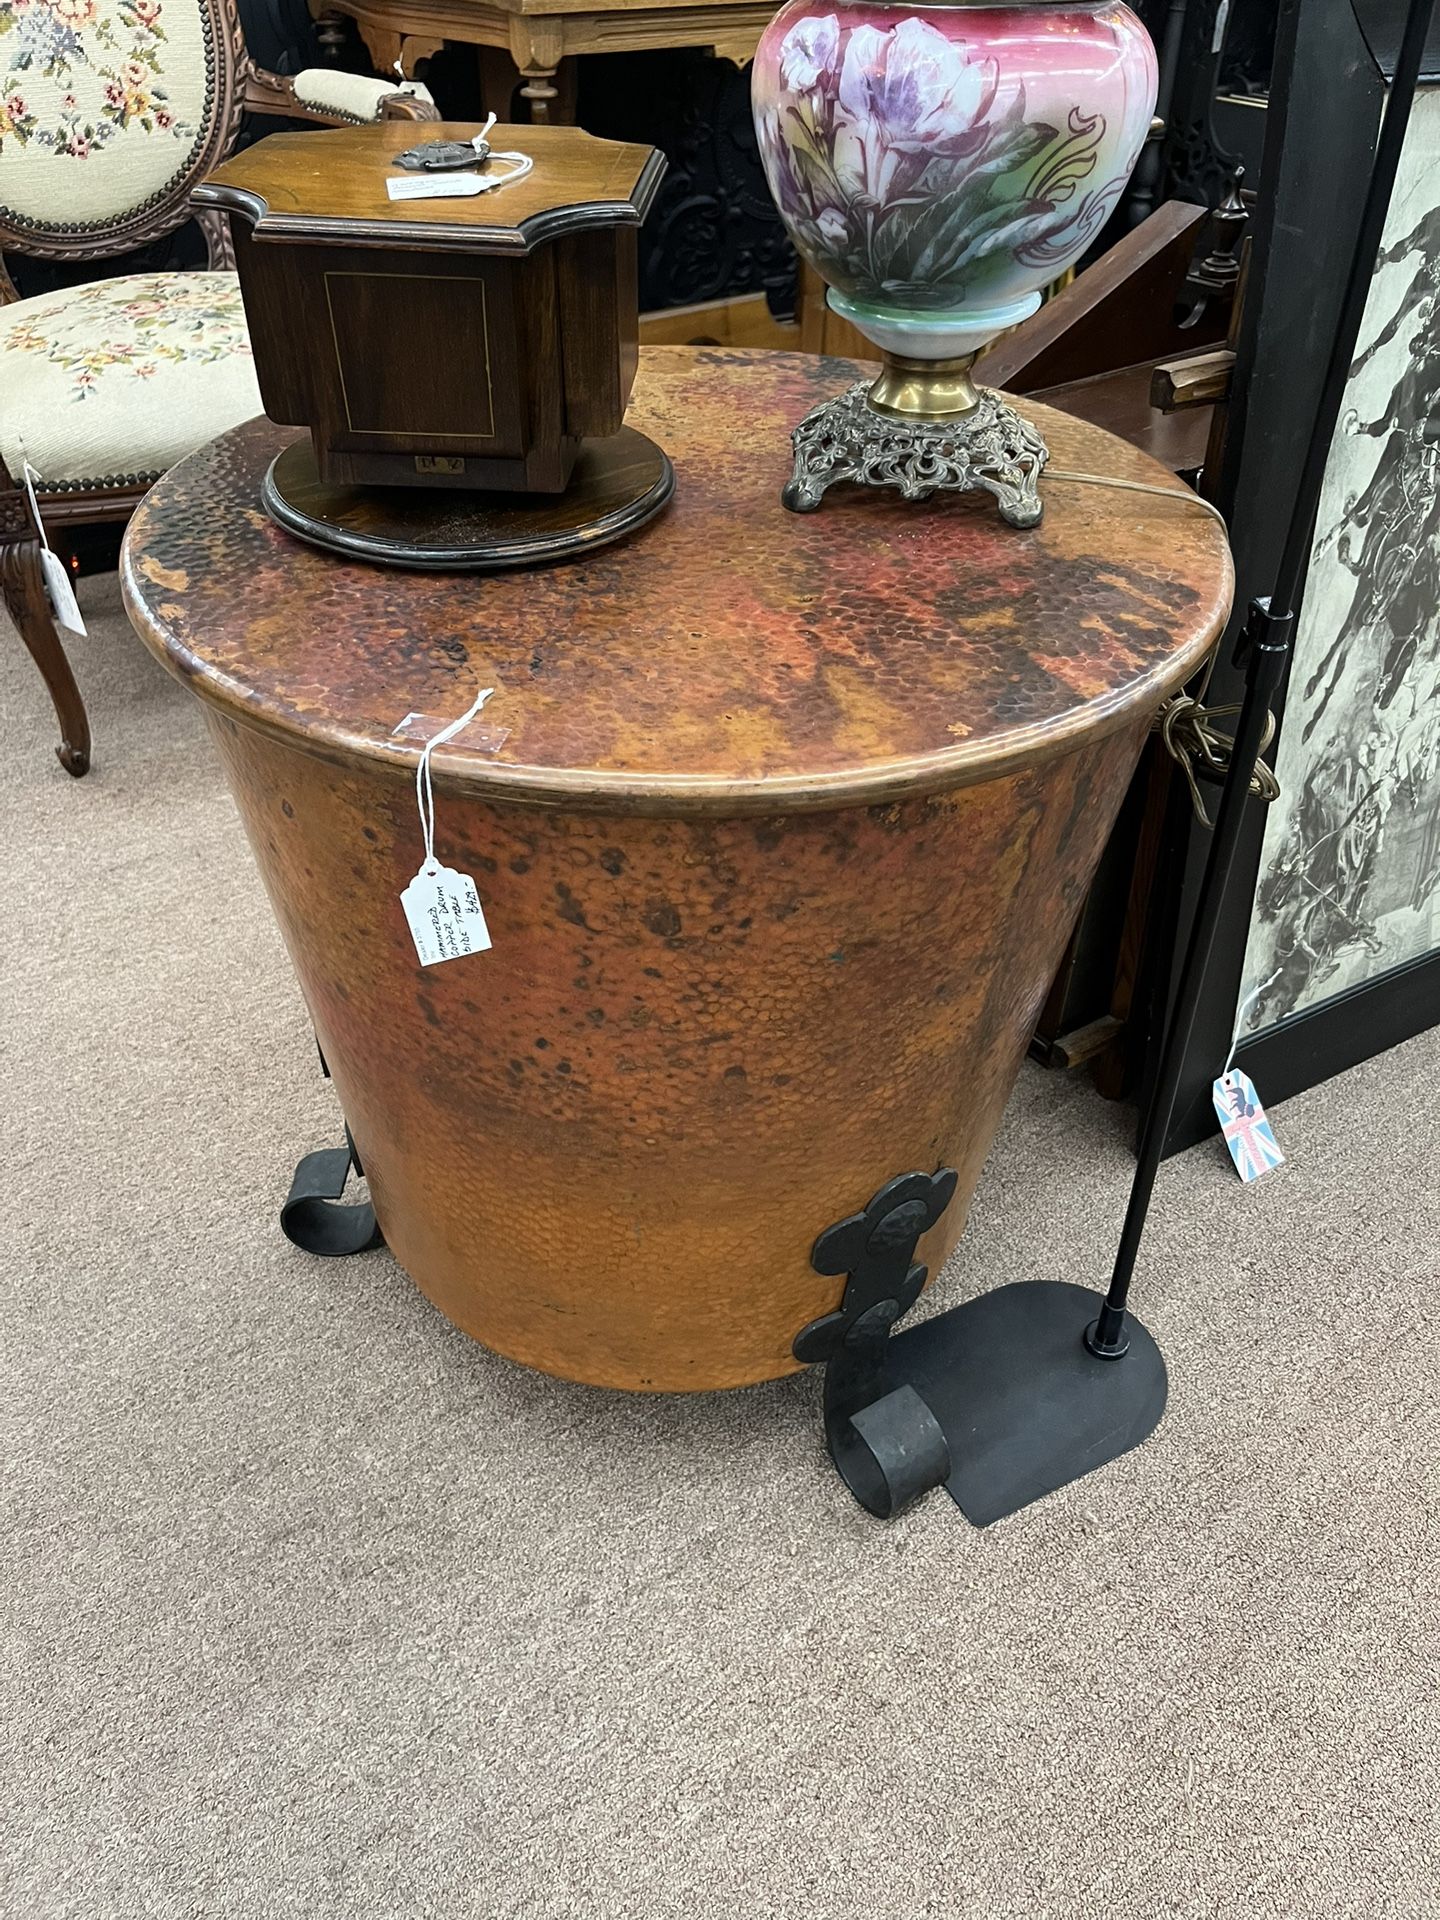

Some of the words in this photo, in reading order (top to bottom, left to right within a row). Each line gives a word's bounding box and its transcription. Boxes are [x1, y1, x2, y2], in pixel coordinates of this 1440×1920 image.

[436, 886, 449, 914] DRUM
[449, 895, 464, 924] TABLE
[427, 906, 447, 958] HAMMERED
[443, 921, 460, 956] COPPER
[459, 928, 471, 952] SIDE
